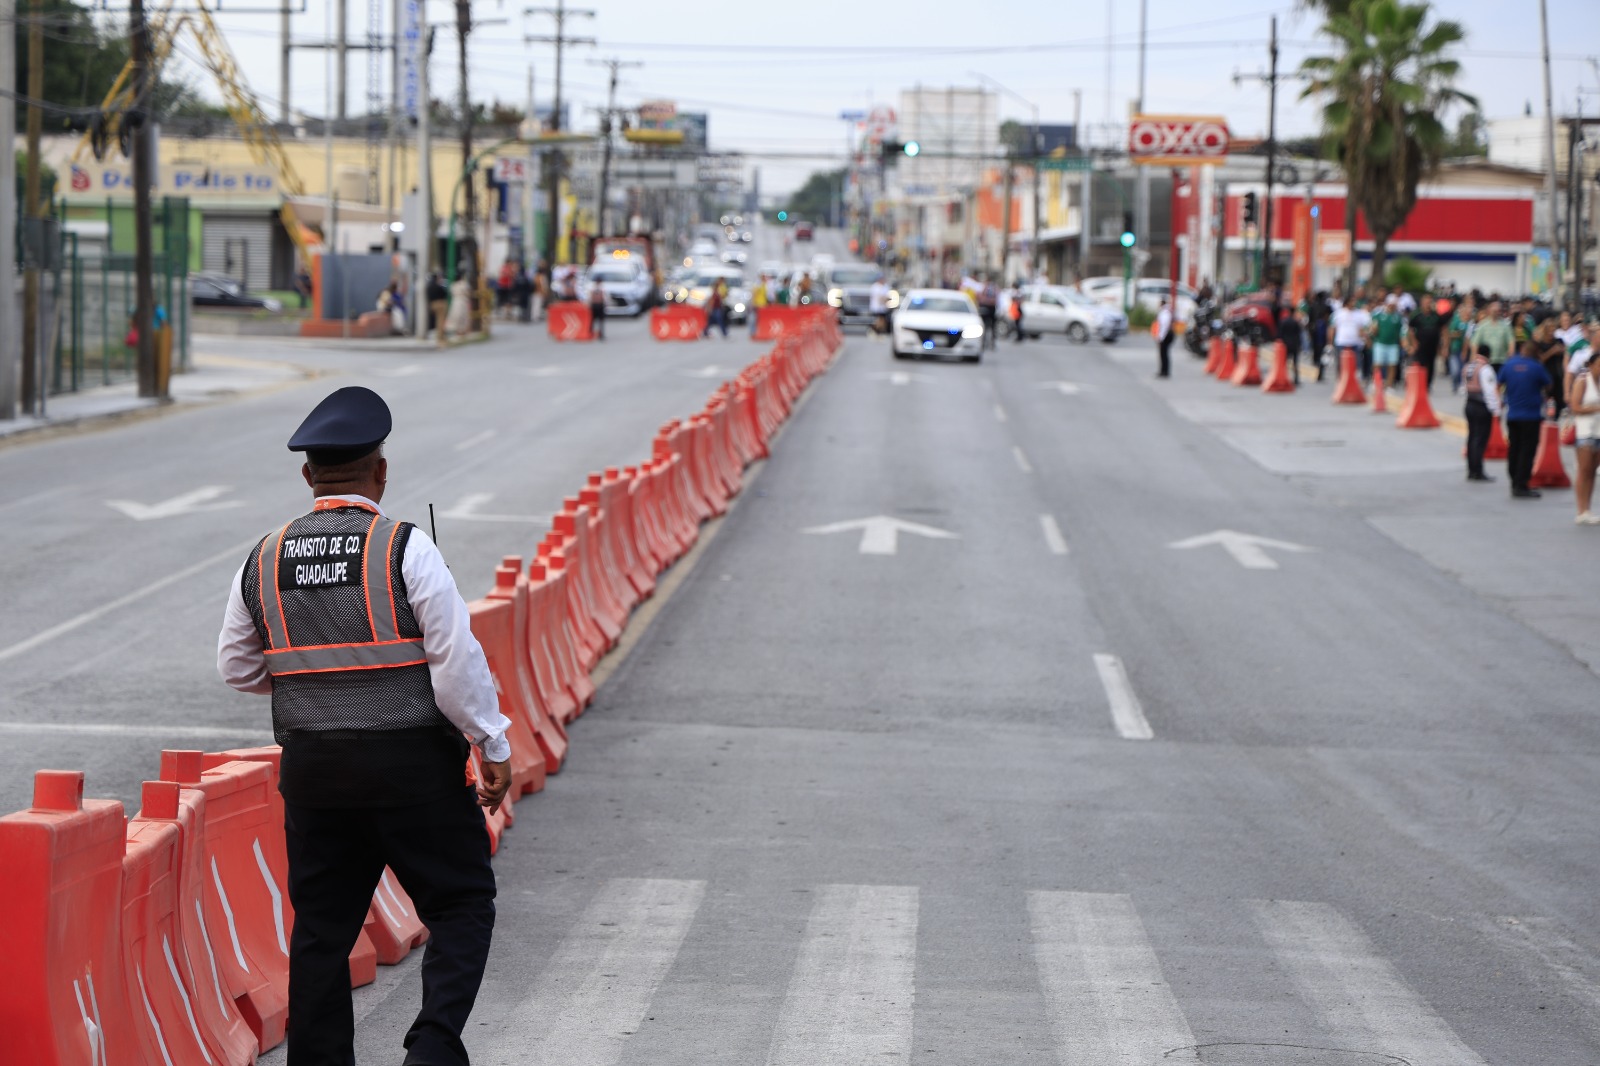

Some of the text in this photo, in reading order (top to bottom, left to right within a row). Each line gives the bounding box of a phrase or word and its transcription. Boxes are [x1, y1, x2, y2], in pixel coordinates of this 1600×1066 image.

[1132, 122, 1229, 156] OXXO
[284, 535, 361, 558] TRÁNSITO DE CD.
[295, 561, 349, 586] GUADALUPE
